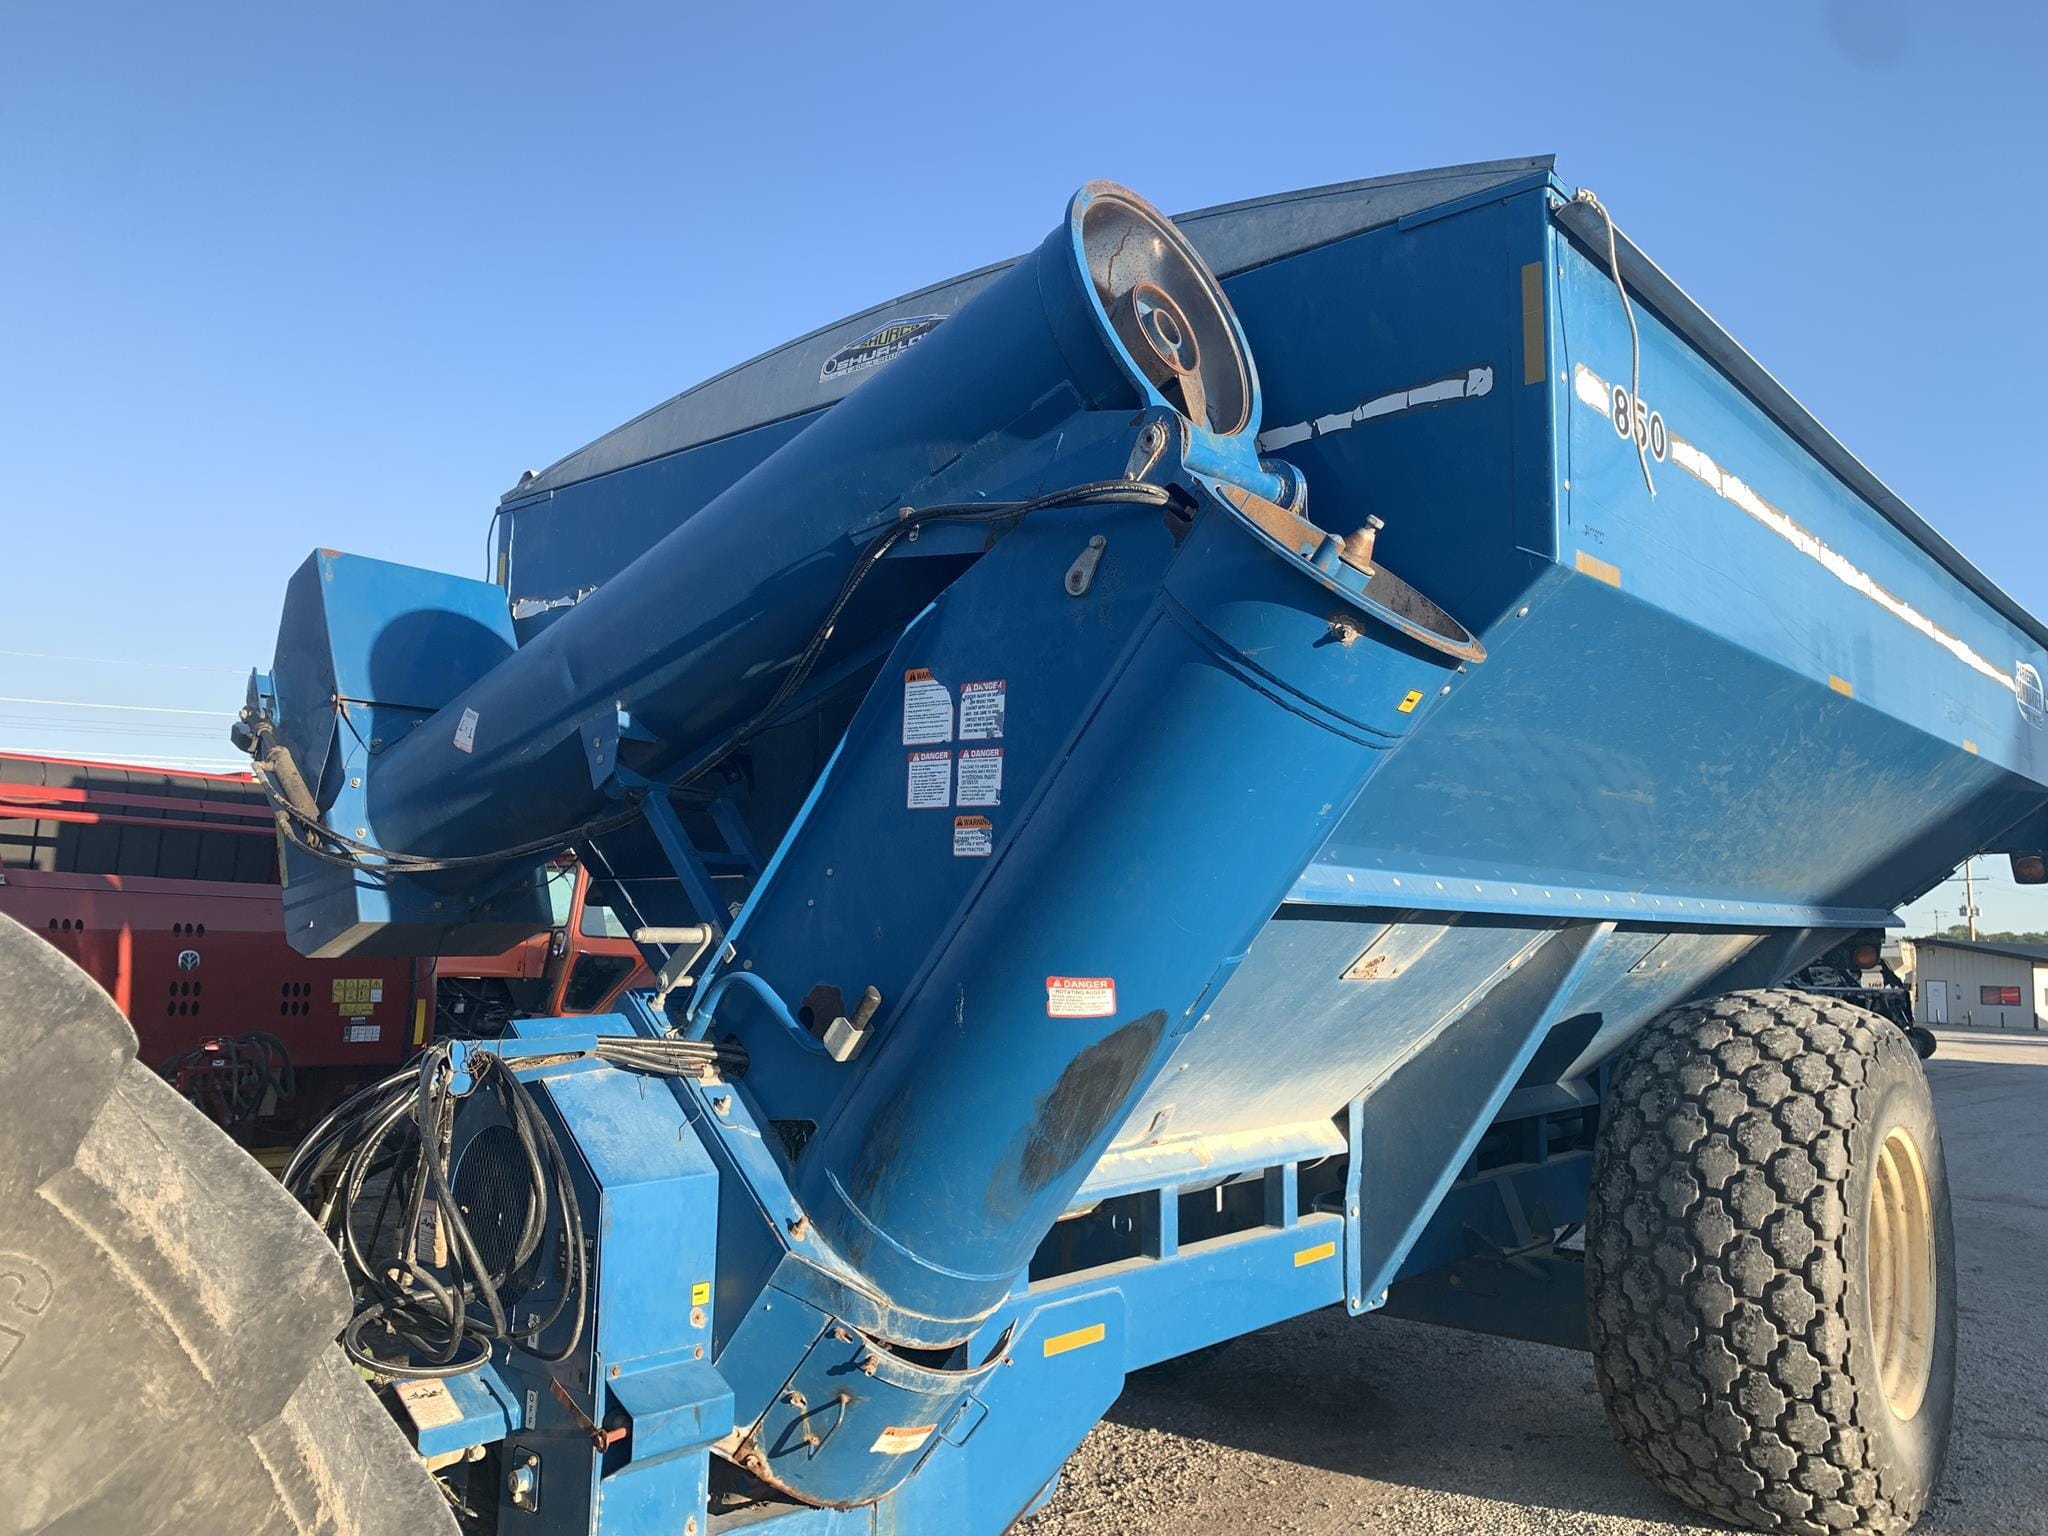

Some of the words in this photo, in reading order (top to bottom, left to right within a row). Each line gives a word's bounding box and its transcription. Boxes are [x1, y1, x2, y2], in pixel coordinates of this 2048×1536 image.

[1613, 385, 1666, 462] 850
[920, 752, 948, 760] DANGER
[971, 749, 999, 757] DANGER
[1063, 980, 1107, 988] DANGER
